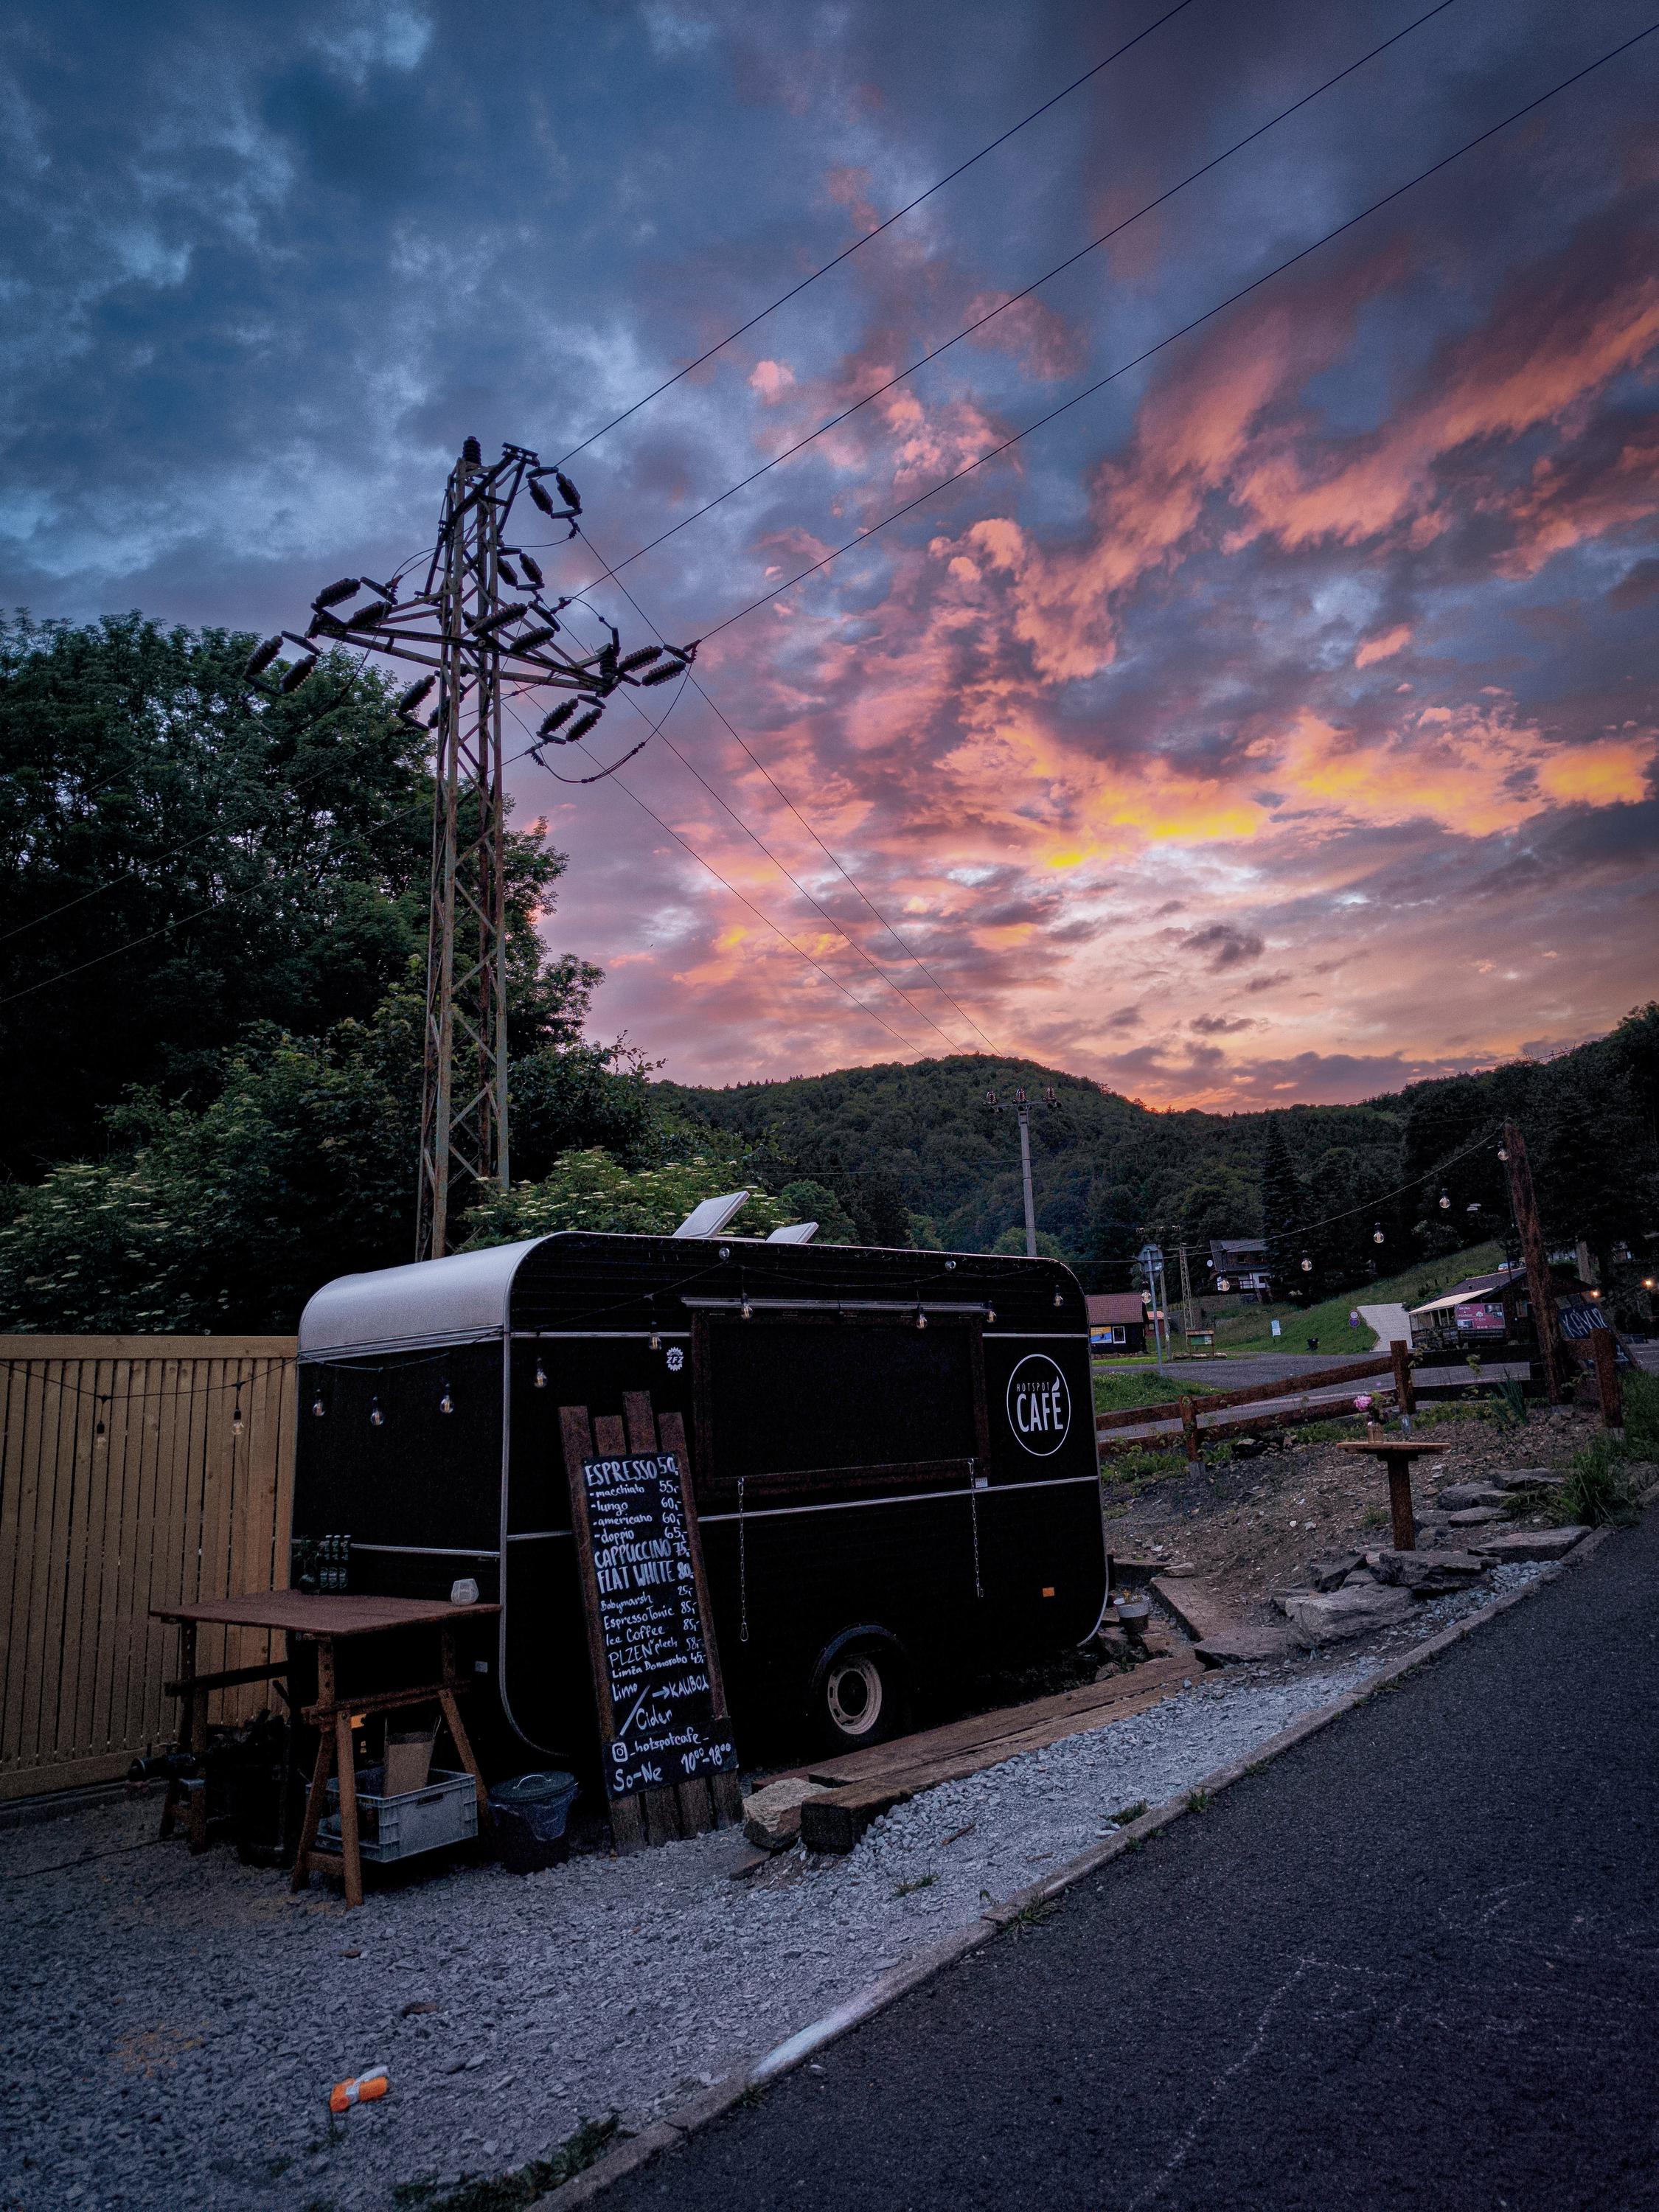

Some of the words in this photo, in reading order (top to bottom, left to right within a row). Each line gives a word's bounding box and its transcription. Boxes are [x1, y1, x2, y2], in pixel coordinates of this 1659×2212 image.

[1016, 1382, 1050, 1392] HOTSPOT
[584, 1460, 657, 1486] ESPRESSO
[594, 1538, 672, 1568] CAPPUCCINO
[597, 1565, 630, 1593] FLAT
[632, 1560, 675, 1587] WHITE
[605, 1633, 622, 1647] Ice
[626, 1625, 665, 1643] Coffee
[612, 1682, 638, 1703] Limo
[636, 1705, 673, 1731] Cider
